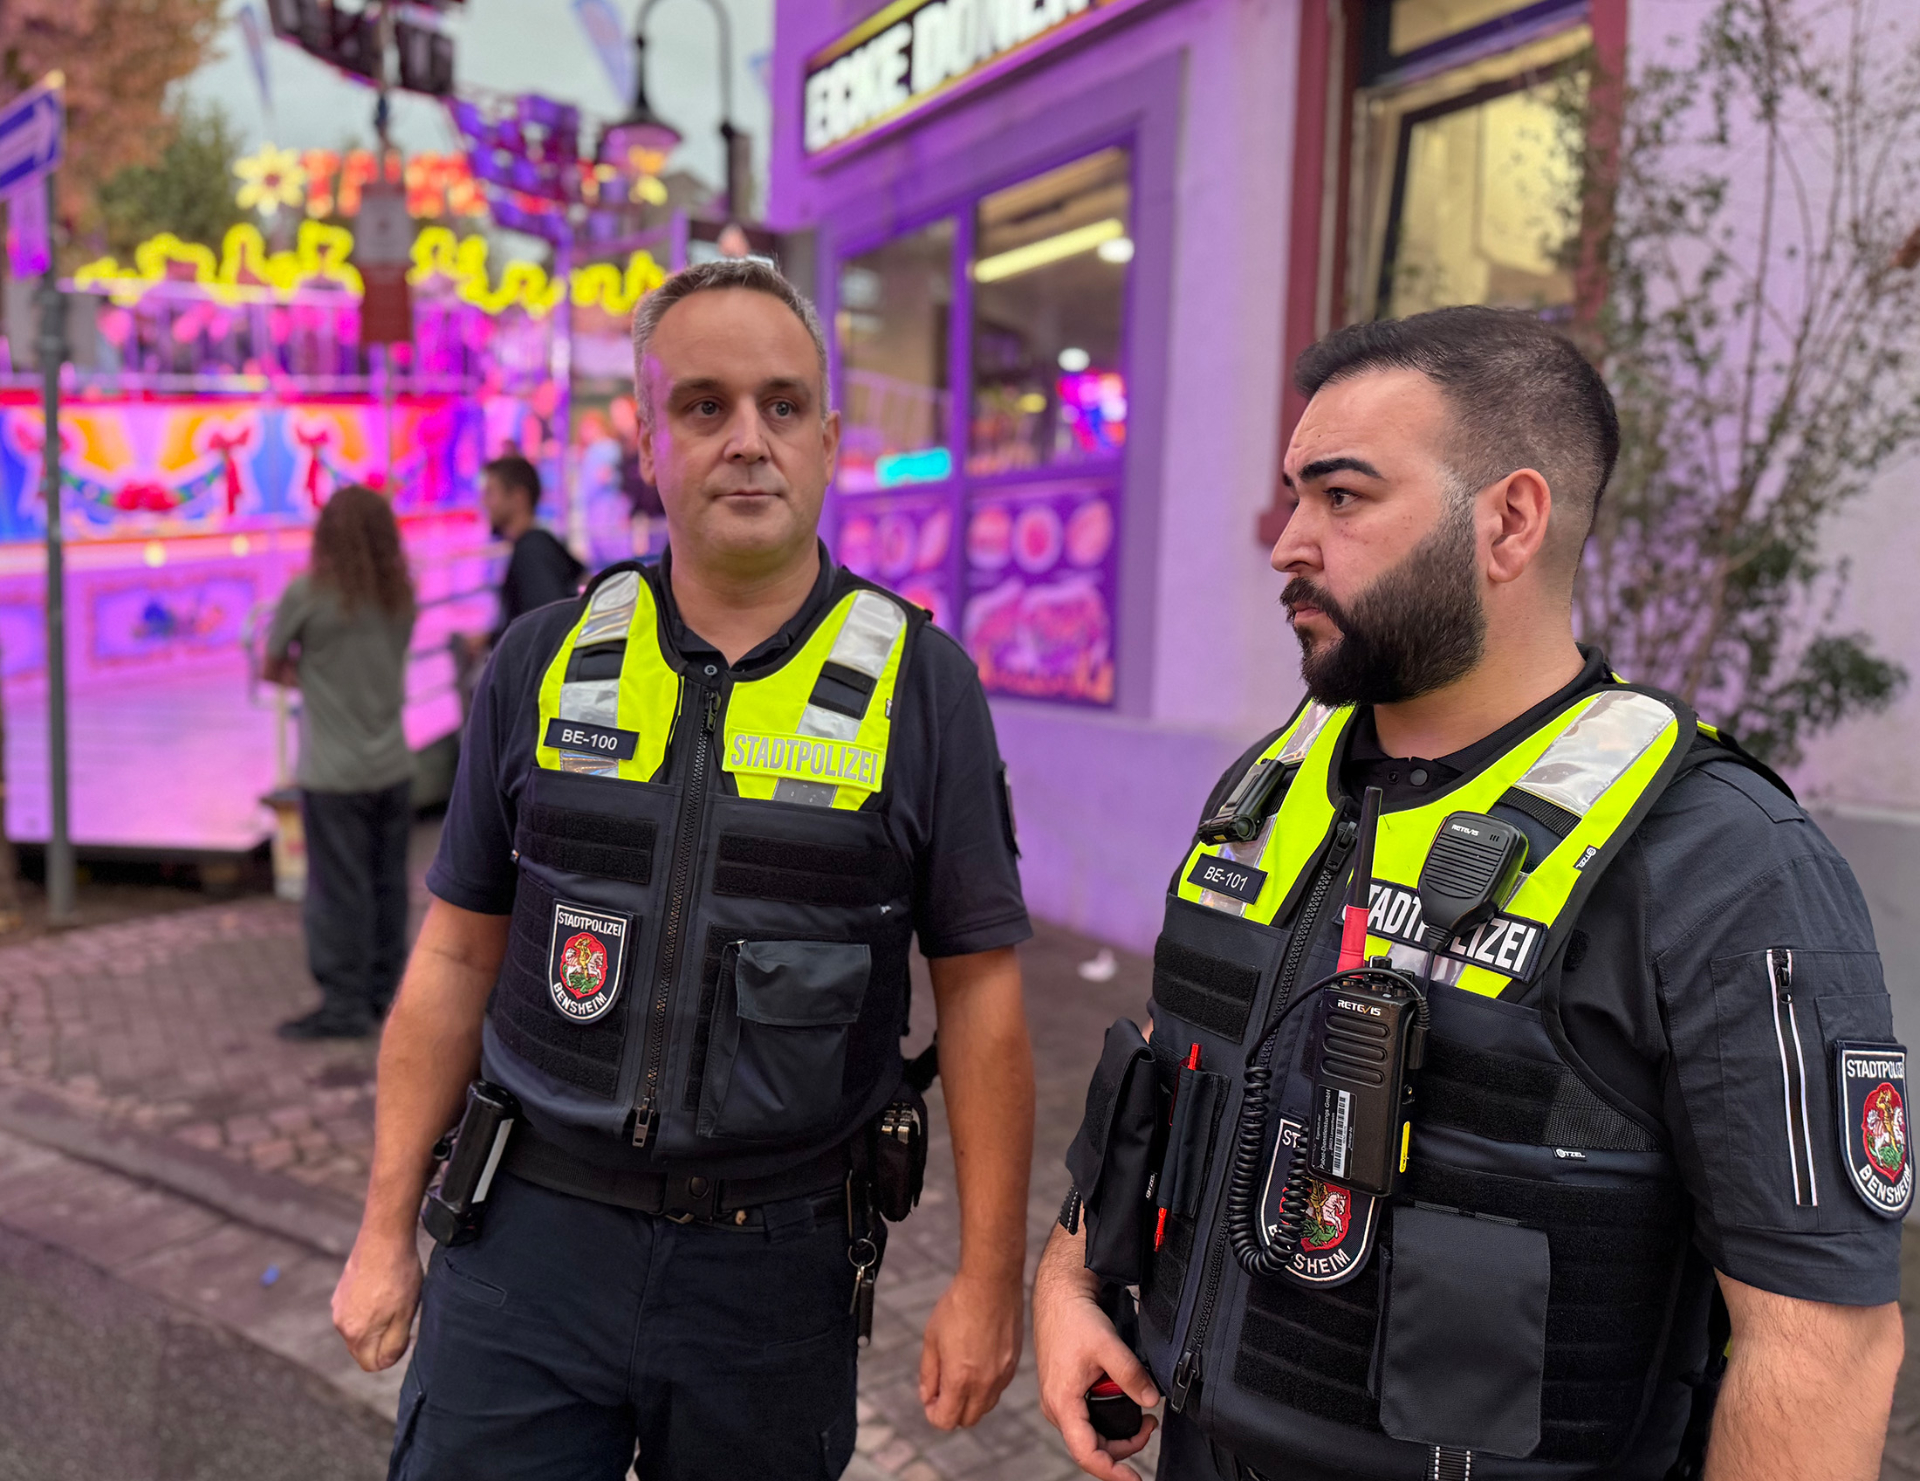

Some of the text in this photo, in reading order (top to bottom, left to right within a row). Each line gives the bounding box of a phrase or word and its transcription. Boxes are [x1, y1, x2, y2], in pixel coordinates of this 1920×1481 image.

[561, 729, 618, 751] BE-100
[730, 733, 878, 785] STADTPOLIZEI
[1451, 824, 1480, 836] RETEVIS
[1203, 866, 1249, 892] BE-101
[558, 911, 622, 937] STADTPOLIZEI
[553, 981, 608, 1016] BENSHEIM
[1337, 999, 1381, 1017] RETEVIS
[1859, 1161, 1911, 1204] BENSHEIM
